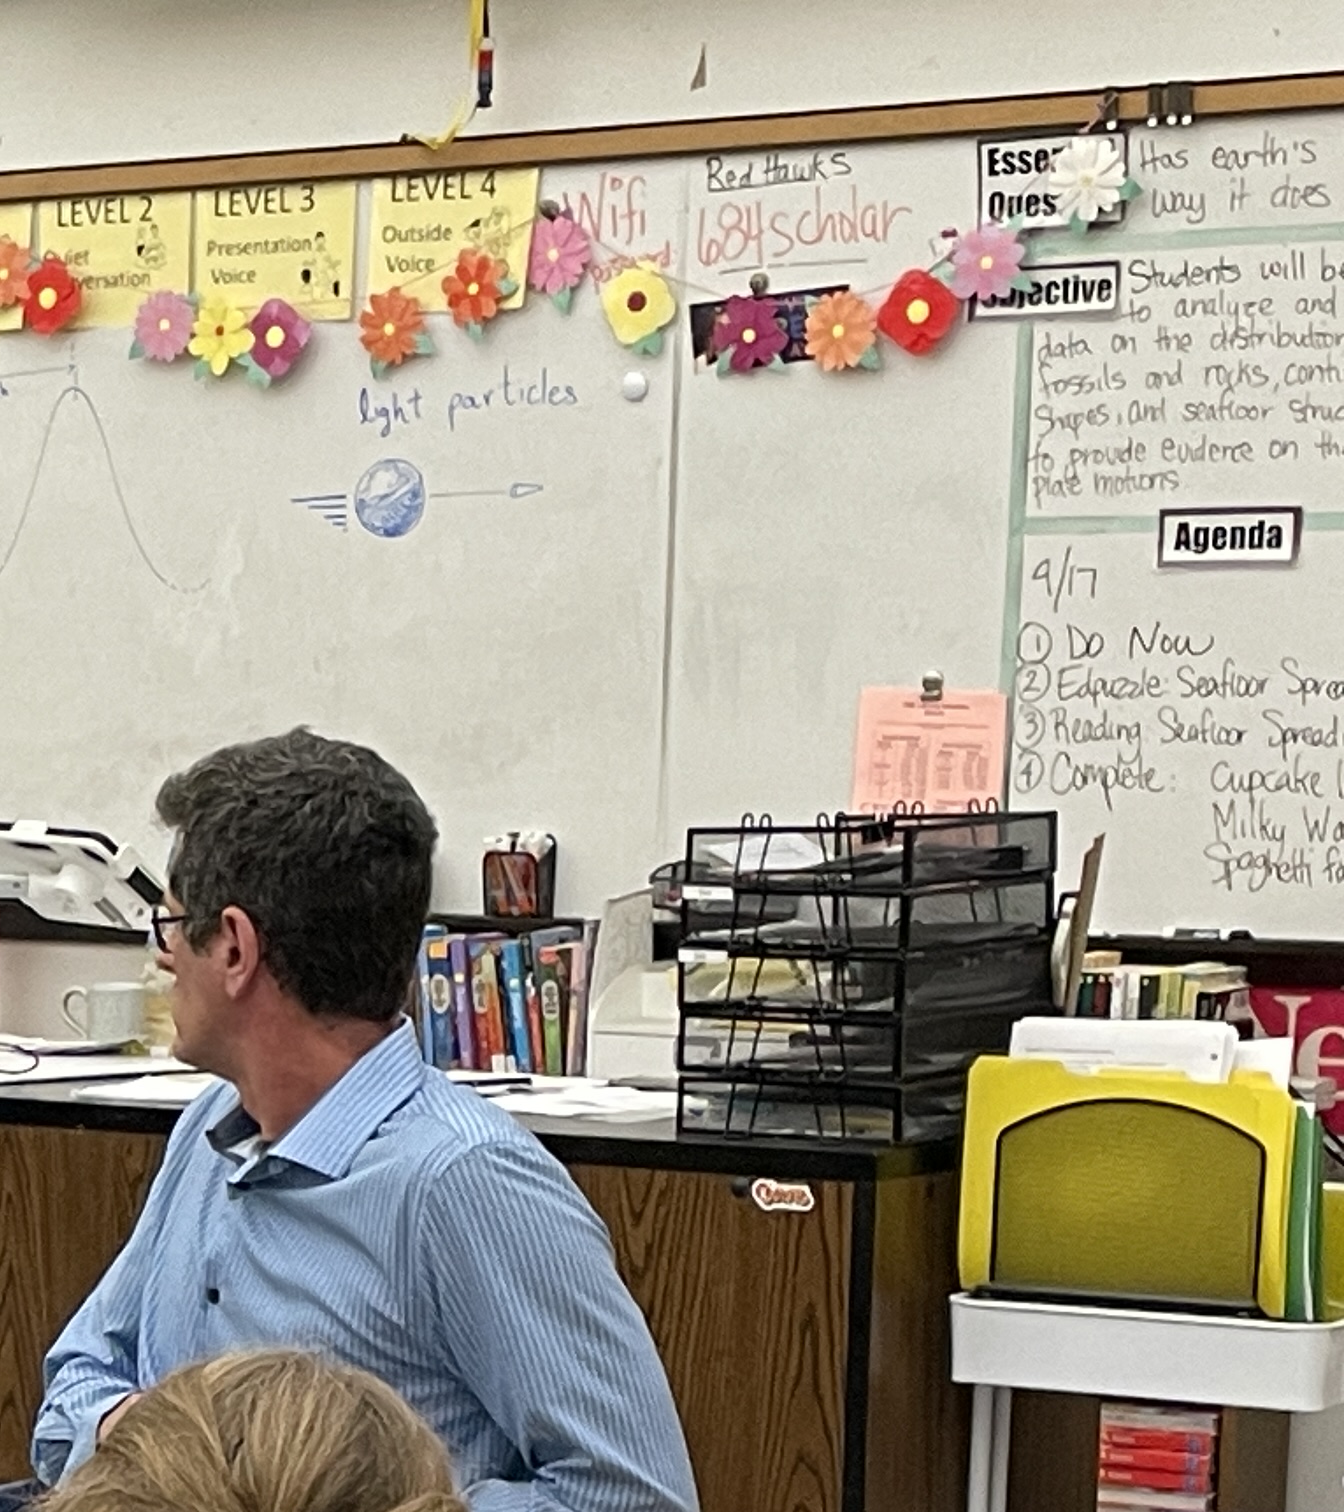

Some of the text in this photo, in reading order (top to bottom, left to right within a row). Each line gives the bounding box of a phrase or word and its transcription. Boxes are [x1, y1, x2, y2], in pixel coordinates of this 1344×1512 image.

[706, 155, 753, 191] Red
[1139, 138, 1189, 173] Has
[214, 184, 315, 218] LEVEL 3
[390, 170, 498, 204] LEVEL 4
[1151, 173, 1331, 224] way it does
[57, 195, 154, 228] LEVEL 2
[207, 236, 313, 258] Presentation
[381, 224, 453, 245] Outside
[210, 267, 257, 285] Voice
[386, 255, 436, 274] Voice
[1128, 259, 1241, 294] Students
[1261, 248, 1305, 281] will
[1127, 299, 1152, 324] to
[1295, 285, 1337, 319] and
[1038, 331, 1093, 361] data
[1112, 332, 1137, 354] on
[1153, 324, 1193, 354] the
[1039, 361, 1127, 399] fossils
[1145, 358, 1183, 388] and
[358, 364, 580, 438] light particles
[1183, 398, 1273, 424] seafloor
[1028, 439, 1055, 474] to
[1066, 435, 1146, 474] provide
[1162, 433, 1254, 465] evidence
[1269, 438, 1299, 461] on
[1033, 470, 1082, 508] plate
[1174, 519, 1283, 554] Agenda
[1067, 622, 1105, 660] Do
[1129, 620, 1215, 660] Now
[1177, 657, 1269, 698] Seafloor
[1157, 704, 1248, 746] Seafloor
[1262, 708, 1344, 763] Spread
[1211, 753, 1325, 808] Cupcake
[1212, 798, 1286, 860] Milky
[1203, 840, 1314, 893] Spaghetti
